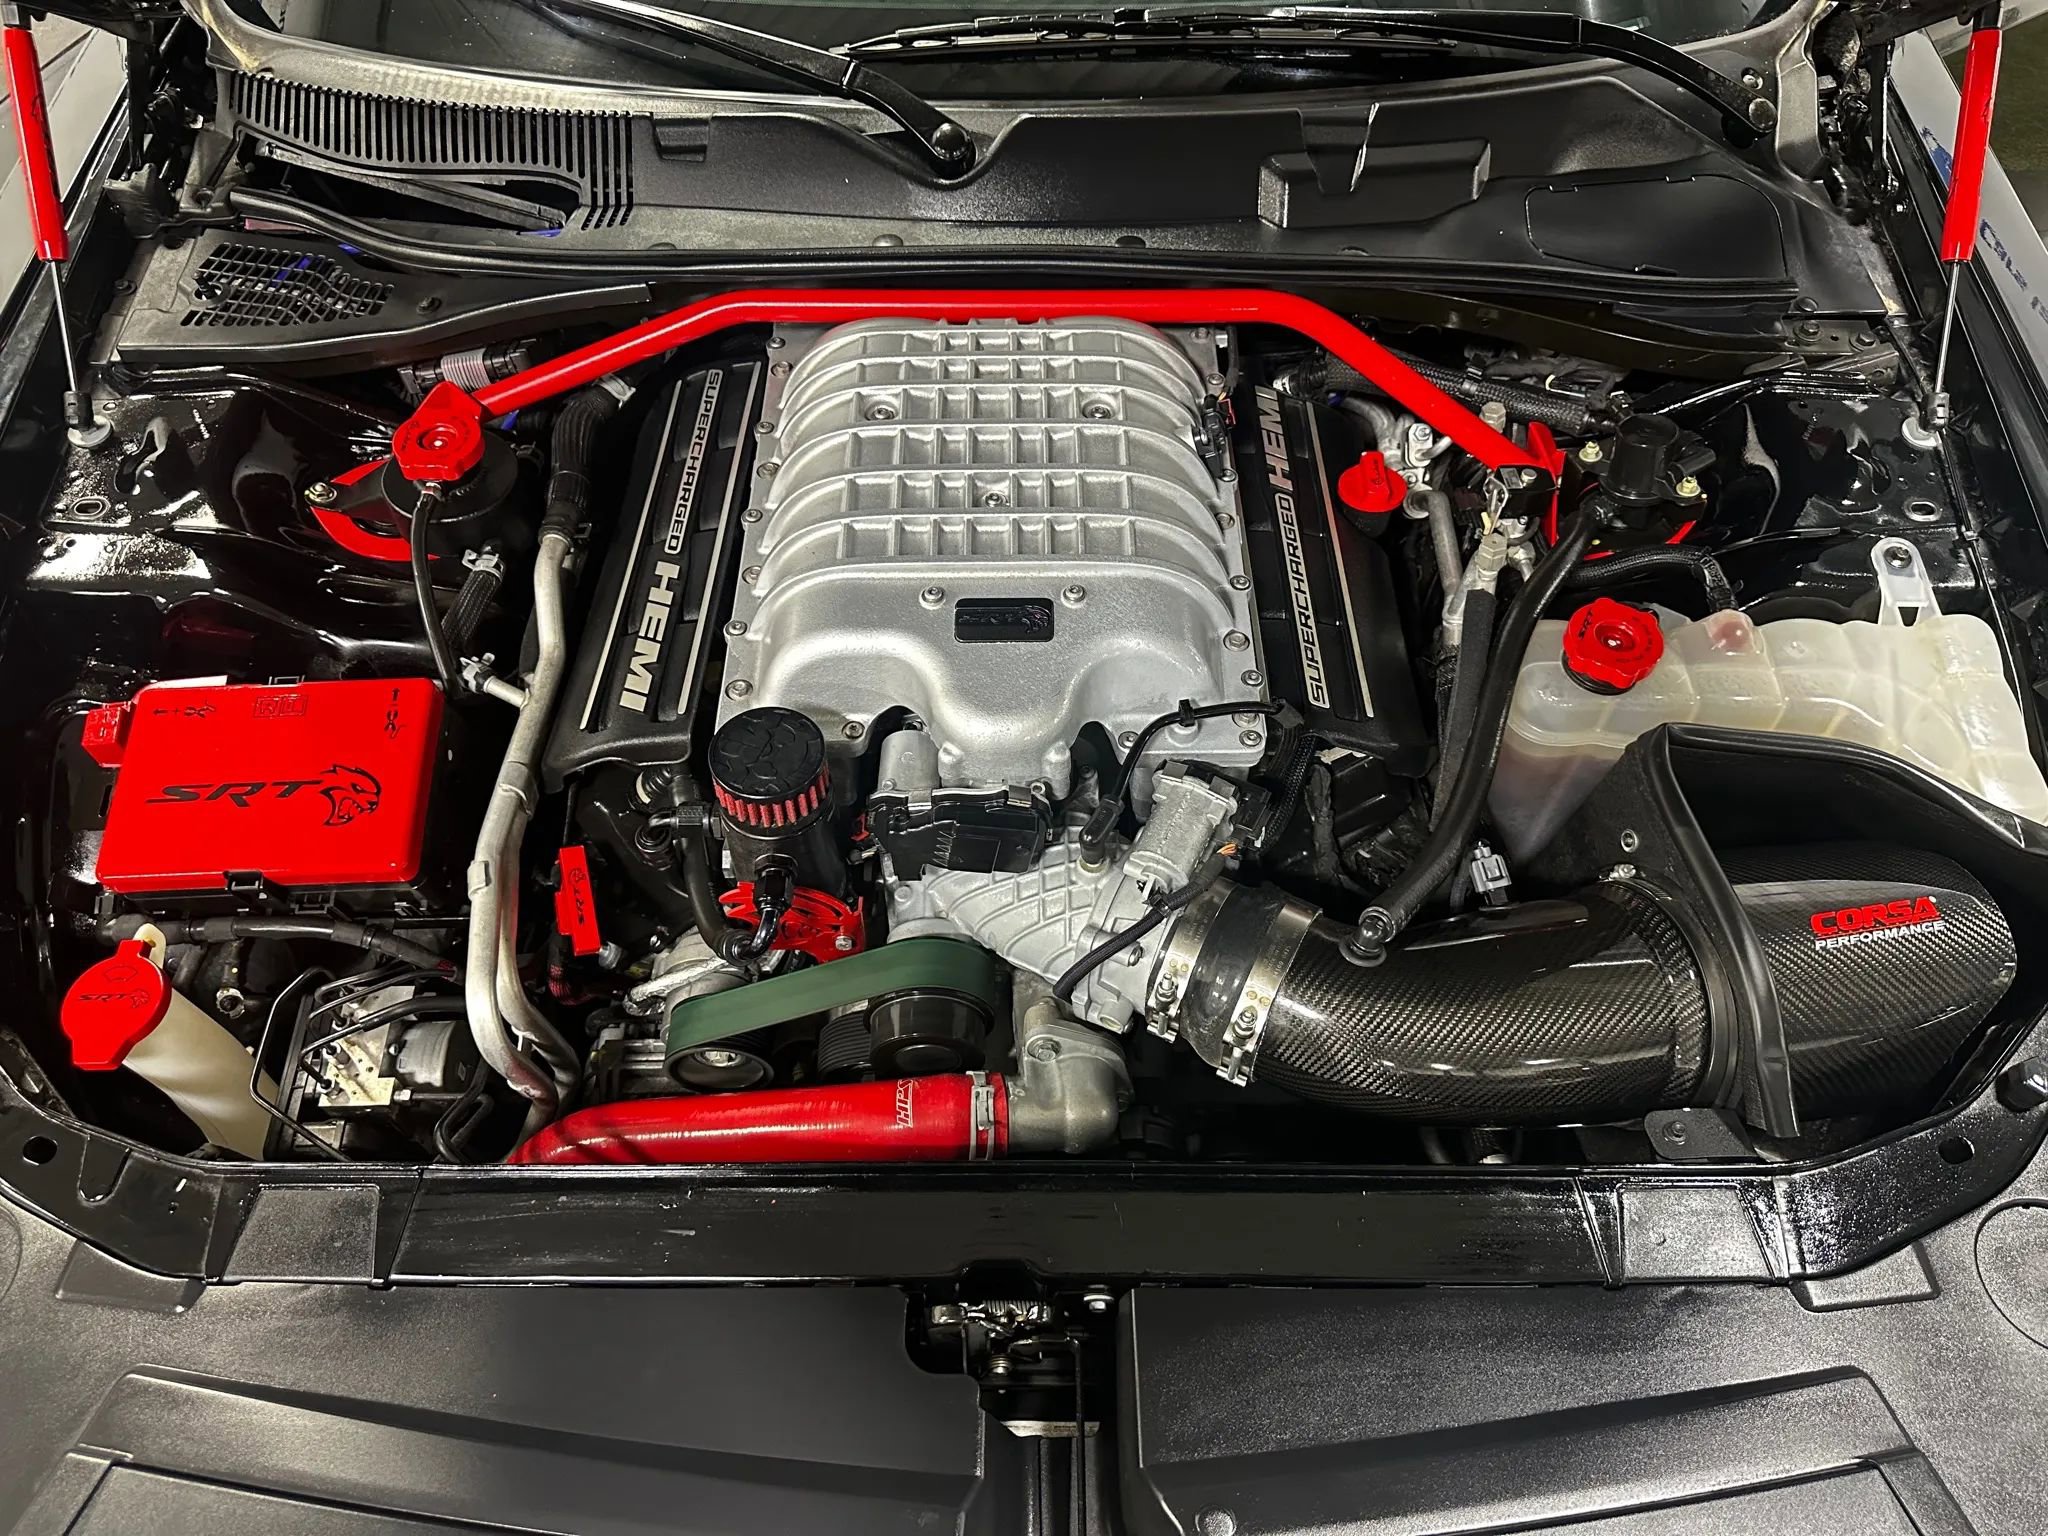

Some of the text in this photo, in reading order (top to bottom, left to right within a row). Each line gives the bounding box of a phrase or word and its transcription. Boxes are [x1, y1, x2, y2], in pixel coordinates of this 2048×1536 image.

[619, 371, 721, 713] SUPERCHARGED HEMI
[1255, 385, 1328, 705] SUPERCHARGED HEMI
[145, 779, 325, 808] SRT
[1810, 896, 1939, 934] CORSA
[1815, 920, 1945, 951] PERFORMANCE
[79, 992, 127, 1003] SRT
[896, 1079, 914, 1128] HPS
